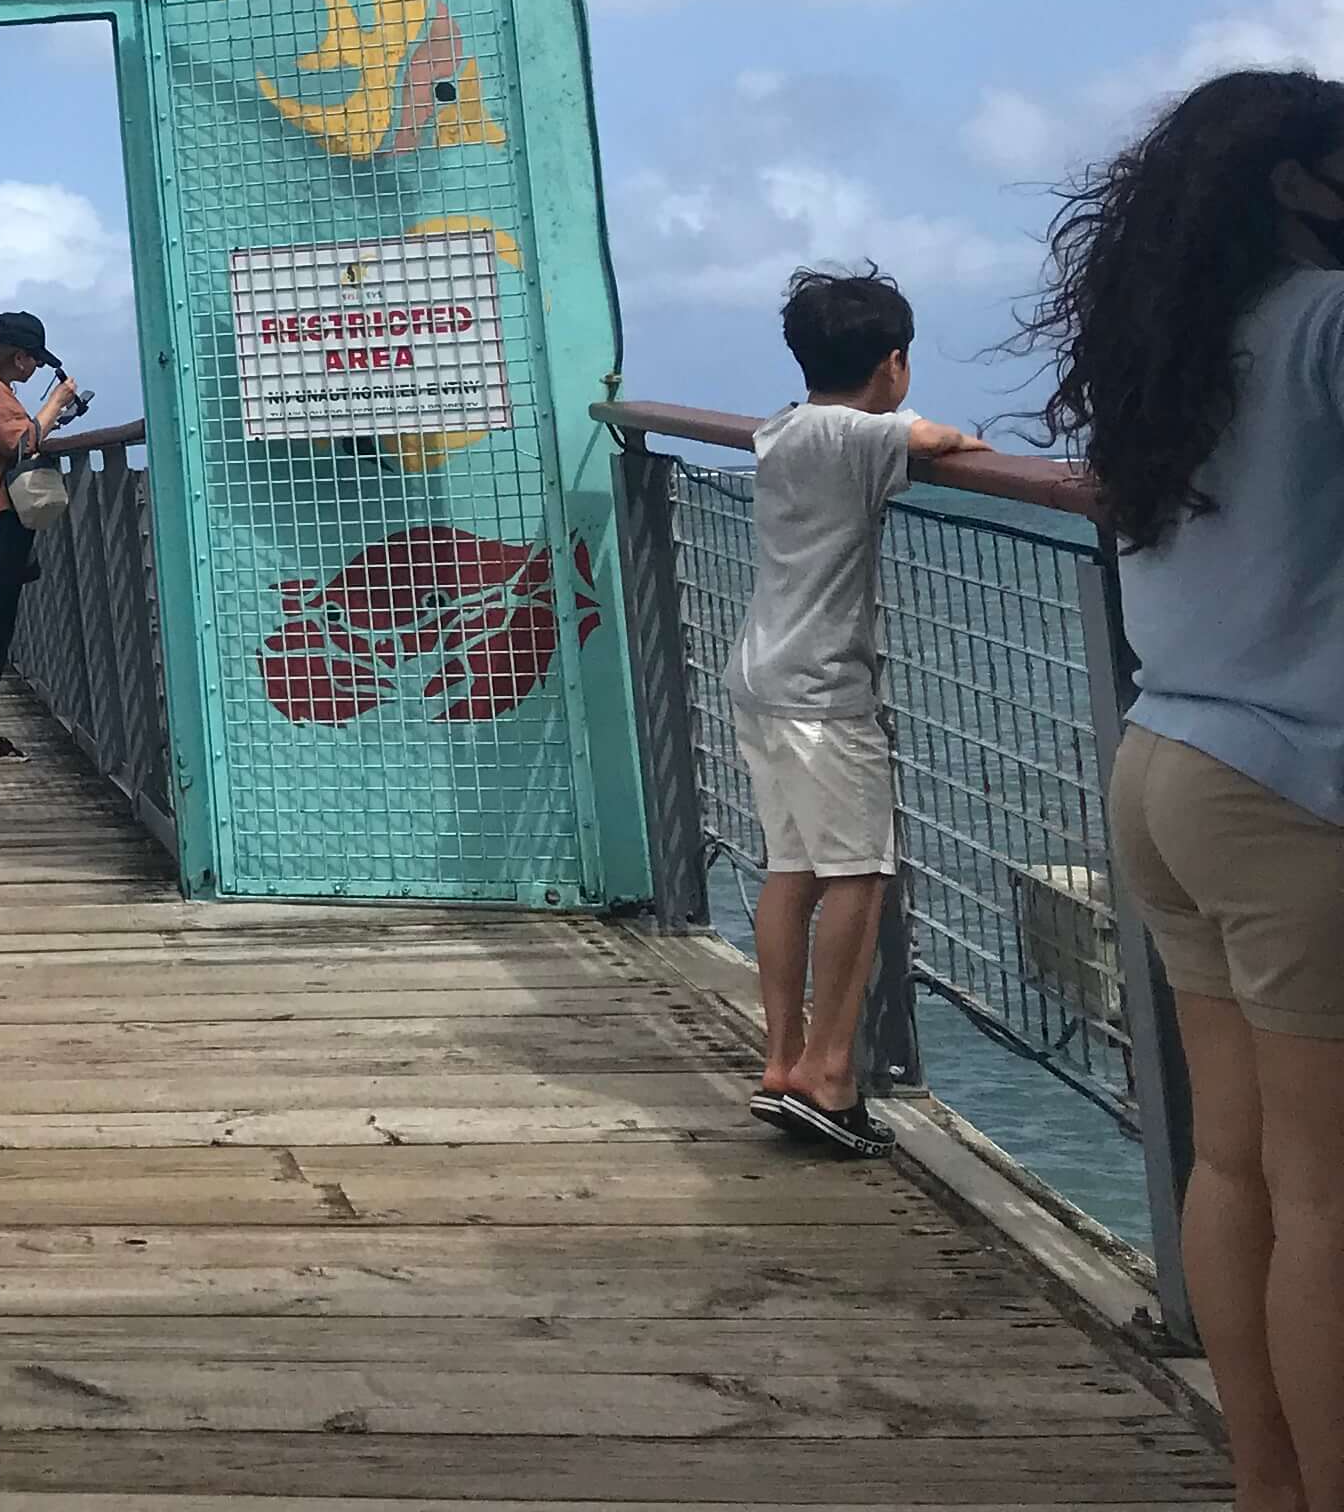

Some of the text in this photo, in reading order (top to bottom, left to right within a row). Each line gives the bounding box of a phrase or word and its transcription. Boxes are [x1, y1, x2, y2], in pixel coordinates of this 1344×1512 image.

[261, 305, 473, 345] RESTRICTED
[325, 345, 414, 371] AREA
[426, 380, 480, 396] ENTRY
